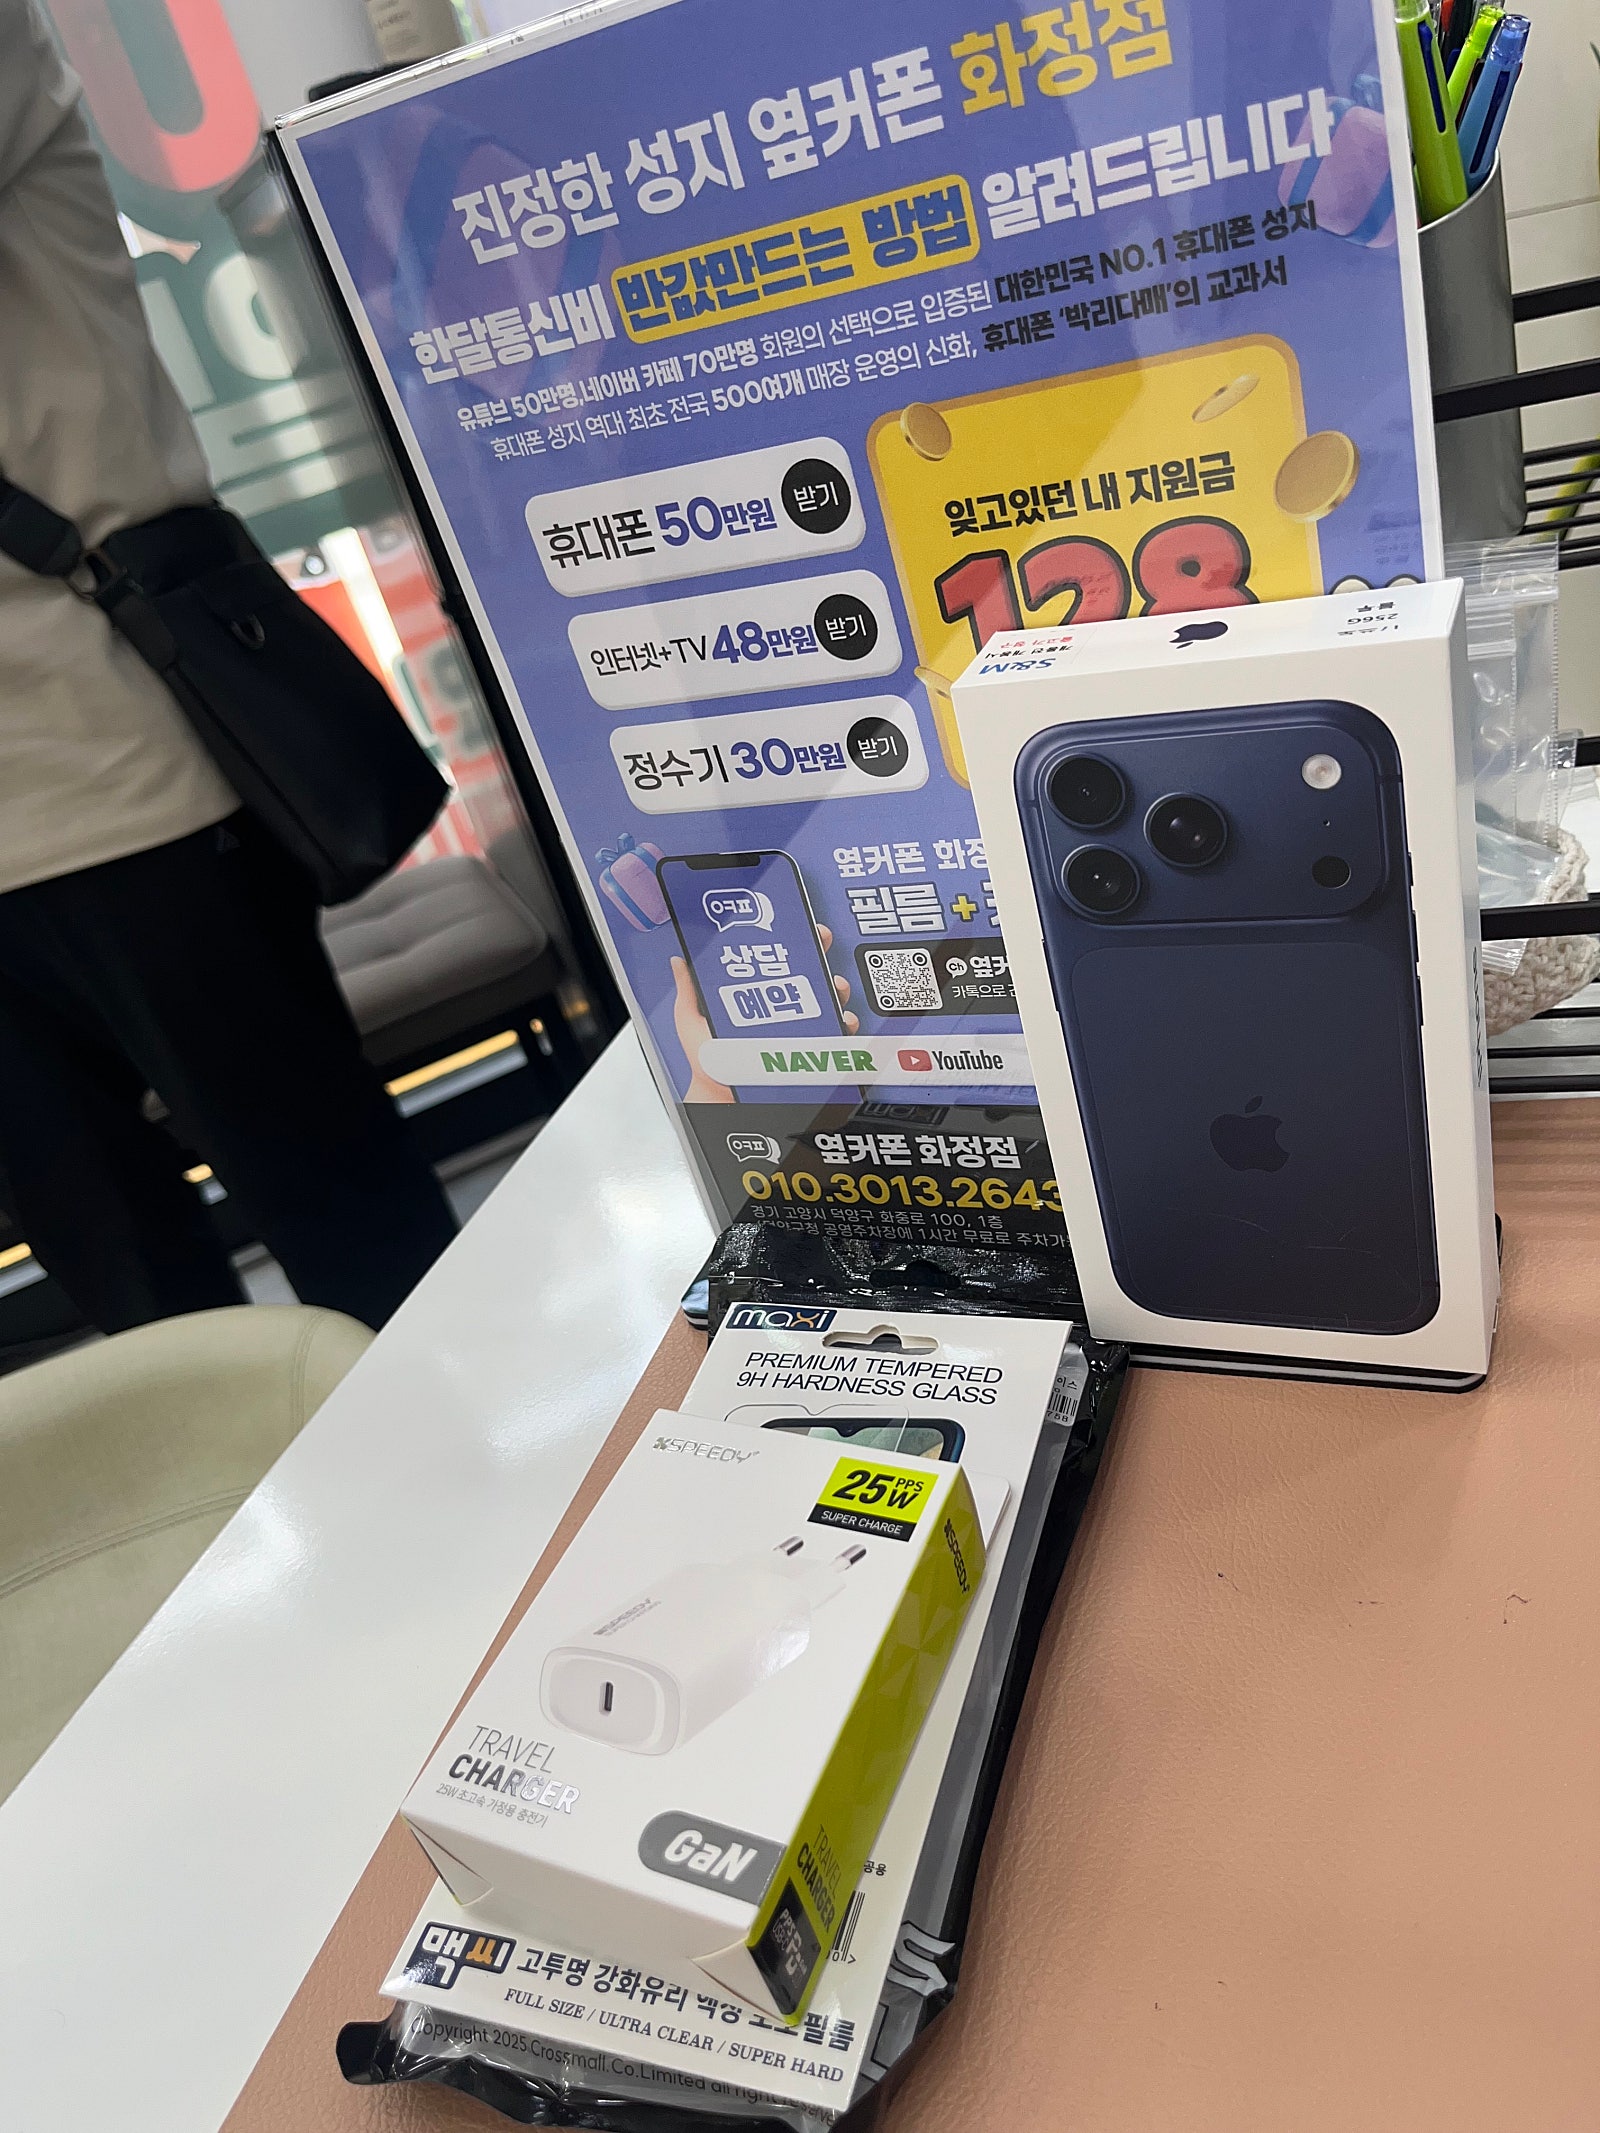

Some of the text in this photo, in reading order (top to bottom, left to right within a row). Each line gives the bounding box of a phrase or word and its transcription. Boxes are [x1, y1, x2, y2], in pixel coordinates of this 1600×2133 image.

[452, 0, 1174, 265] 진정한 성지 옆커폰 화정점
[409, 87, 1334, 385] 한달통신비 반값만드는 방법 알려드립니다
[457, 399, 512, 432] 유튜브
[641, 356, 685, 390] 카페
[683, 338, 759, 378] 70만명
[759, 321, 825, 361] 회원의
[828, 299, 918, 346] 선택으로
[920, 280, 993, 325] 입증된
[994, 255, 1095, 304] 대한민국
[1099, 237, 1167, 280] NO.1
[1172, 214, 1255, 262] 휴대폰
[1261, 199, 1318, 242] 성지
[490, 429, 547, 462] 휴대폰
[547, 420, 586, 451] 성지
[585, 410, 627, 440] 역대
[626, 401, 668, 433] 최초
[667, 392, 711, 423] 전국
[711, 369, 807, 413] 500여개
[806, 358, 851, 391] 매장
[853, 341, 921, 383] 운영의
[925, 330, 978, 367] 신화,
[981, 310, 1056, 352] 휴대폰
[1206, 255, 1288, 303] 교과서
[792, 481, 840, 514] 받기
[944, 450, 1237, 538] 잊고있던 내 지원금
[542, 495, 779, 570] 휴대폰 50만원
[934, 515, 1261, 655] 128
[825, 613, 868, 642] 받기
[1347, 613, 1399, 625] 256G
[590, 621, 820, 678] 인터넷+TV 48만원
[979, 658, 1056, 675] S&M
[624, 737, 847, 791] 정수기 30만원
[857, 735, 899, 760] 받기
[833, 841, 926, 878] 옆커폰
[847, 883, 946, 934] 필름
[720, 943, 791, 978] 상담
[733, 983, 804, 1020] 예약
[952, 984, 1008, 999] 카톡으로
[760, 1049, 1004, 1073] NAVER YouTube
[814, 1133, 1022, 1169] 옆커폰 화정점
[742, 1171, 1064, 1212] 010.3013.2643
[751, 1205, 780, 1218] 경기
[783, 1206, 827, 1221] 고양시
[830, 1208, 875, 1222] 덕양구
[879, 1210, 926, 1226] 화중로
[977, 1215, 1004, 1229] 1층
[824, 1222, 913, 1241] 공영주차장에
[918, 1227, 959, 1243] 1시간
[963, 1229, 1012, 1245] 무료로
[1016, 1231, 1071, 1248] 주차가
[733, 1308, 830, 1330] maxi
[745, 1352, 1003, 1384] PREMIUM TEMPERED
[736, 1372, 997, 1405] 9H HARDNESS GLASS
[895, 1478, 924, 1492] PPS
[821, 1510, 903, 1534] SUPER CHARGE
[469, 1725, 555, 1774] TRAVEL
[449, 1754, 581, 1814] CHARGER
[436, 1782, 549, 1828] 25W 초고속 가정용 충전기
[664, 1829, 758, 1883] GaN
[814, 1824, 842, 1900] TRAVEL
[797, 1842, 836, 1934] CHARGER
[516, 1948, 591, 1987] 고투명
[594, 1963, 689, 2012] 강화유리
[411, 2016, 489, 2043] Copyright
[504, 1988, 545, 2009] FULL
[548, 1998, 585, 2019] SIZE
[599, 2010, 652, 2036] ULTRA
[656, 2025, 715, 2051] CLEAR
[728, 2042, 787, 2068] SUPER
[790, 2057, 844, 2082] HARD
